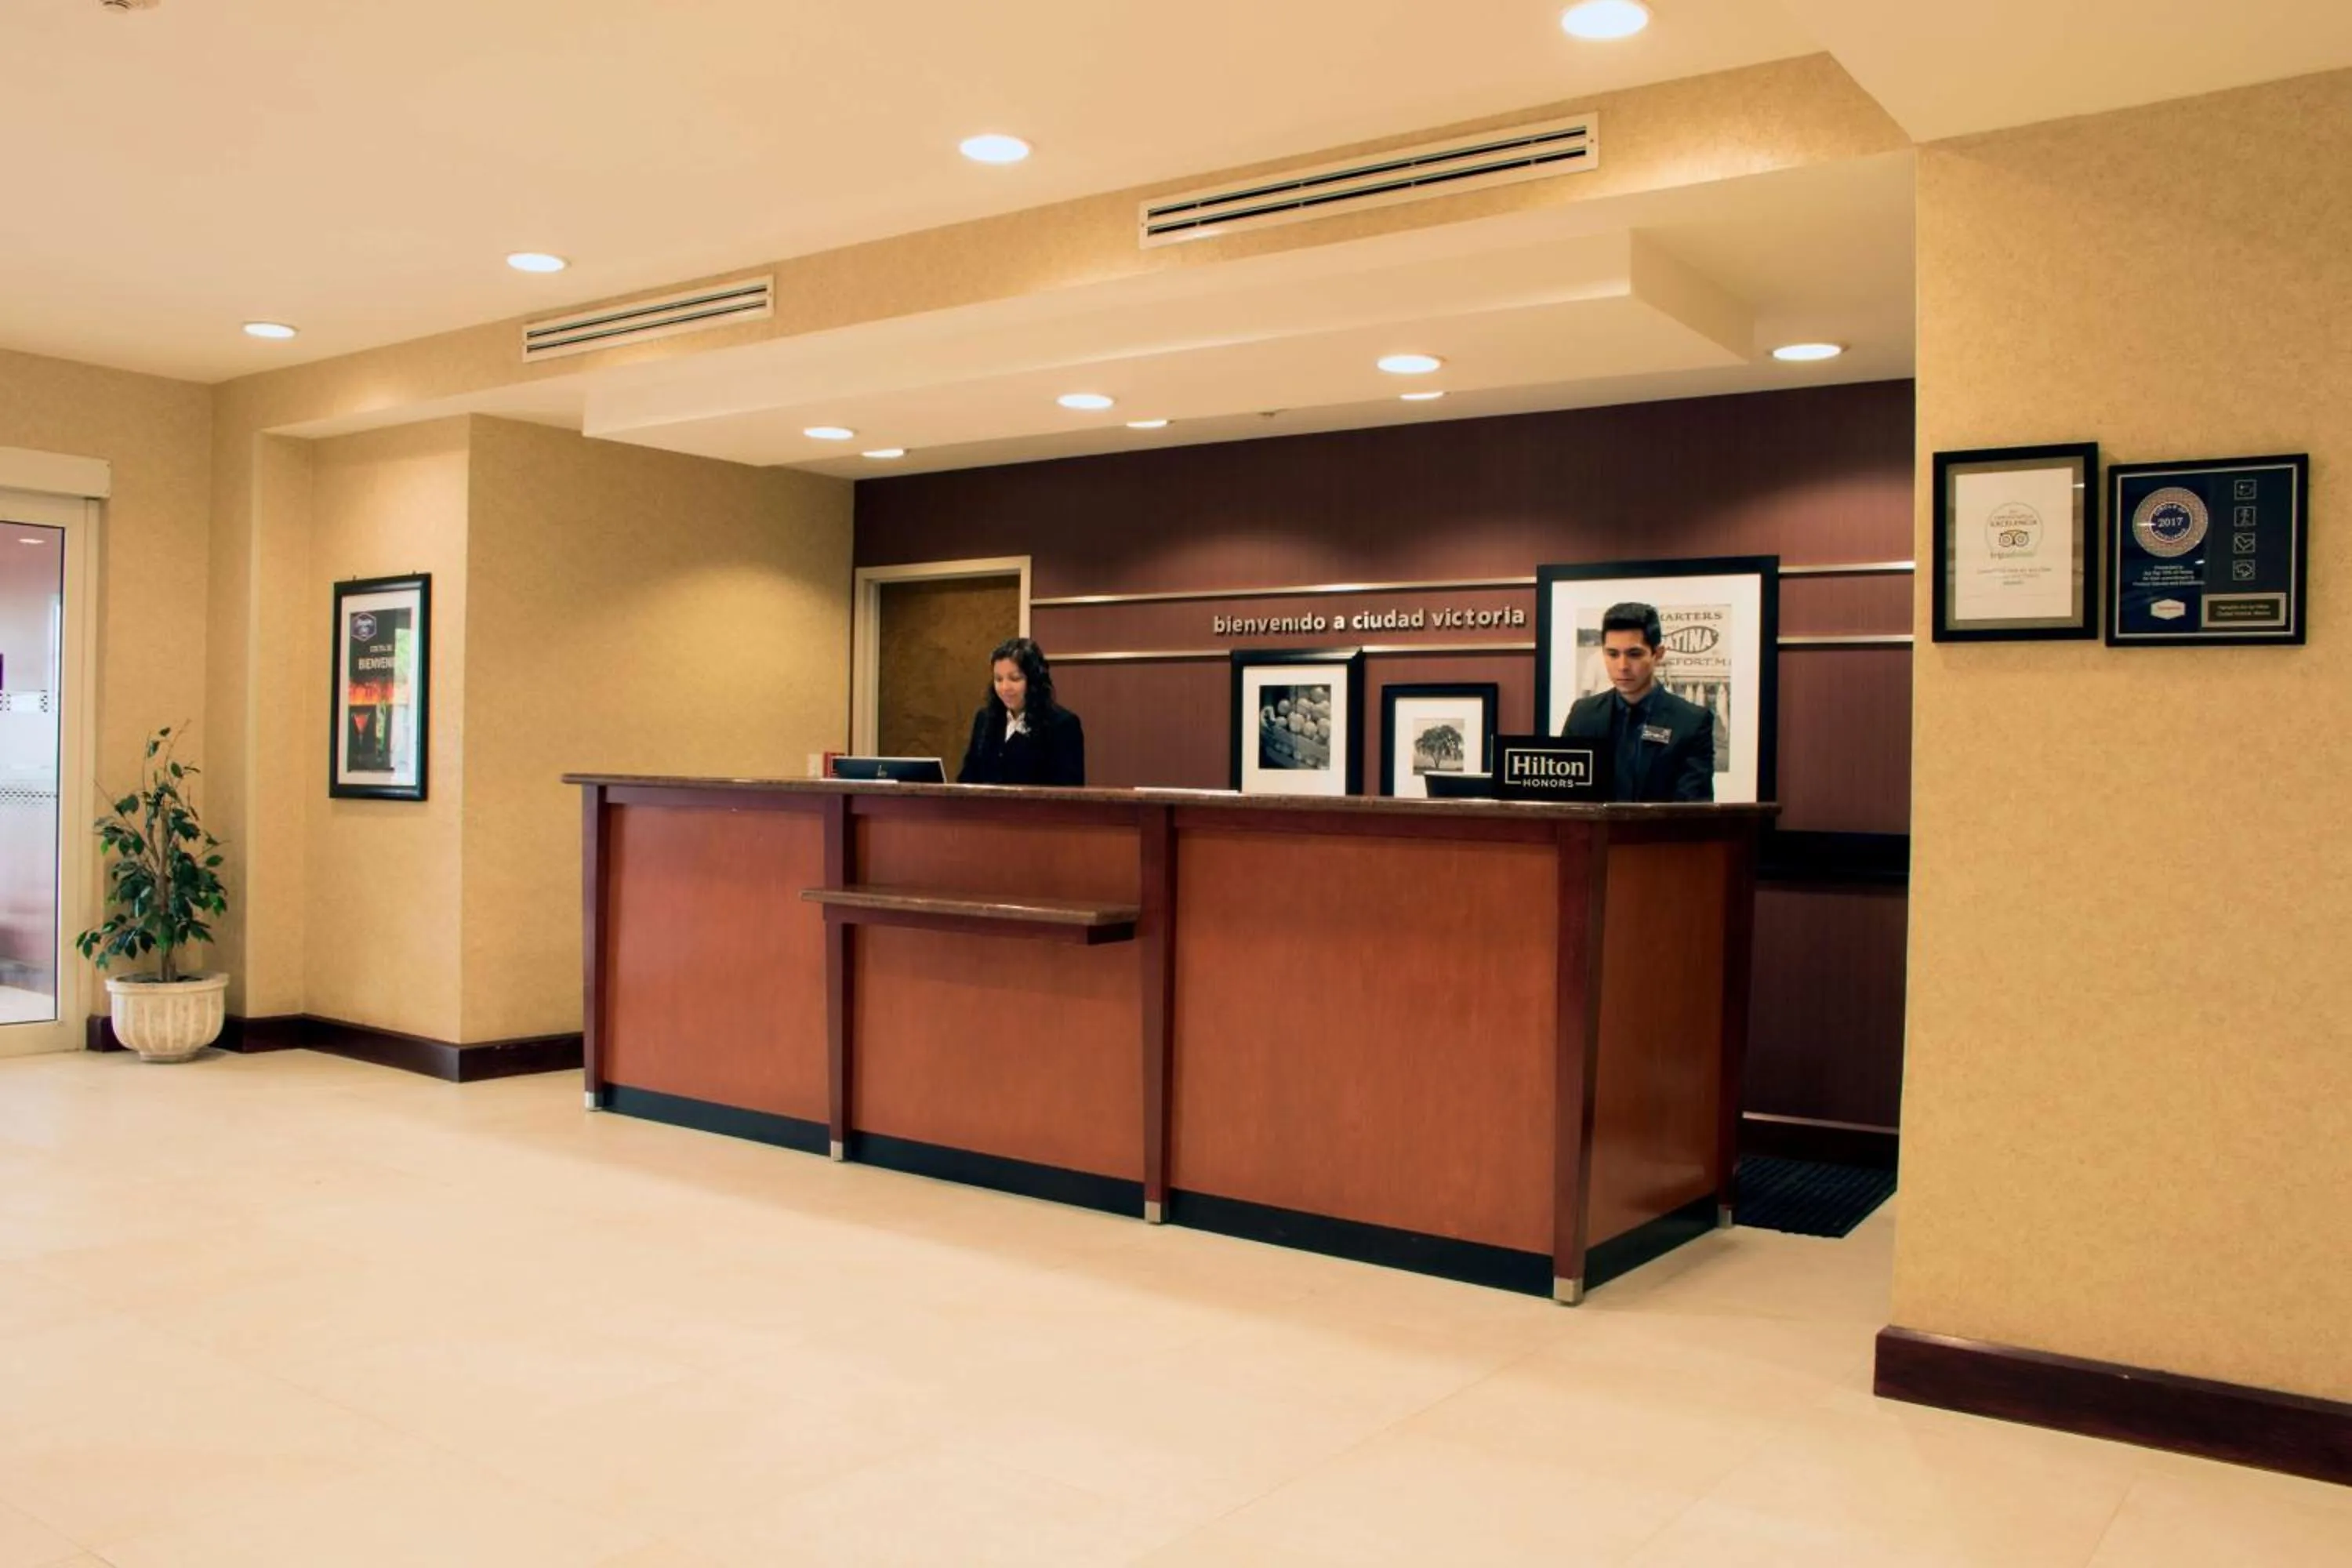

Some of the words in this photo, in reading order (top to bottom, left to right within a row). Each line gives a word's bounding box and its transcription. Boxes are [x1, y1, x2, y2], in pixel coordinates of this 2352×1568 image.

[2157, 517, 2183, 528] 2017
[1214, 613, 1326, 633] bienvenido
[1333, 615, 1346, 630] a
[1352, 609, 1425, 630] ciudad
[1432, 606, 1525, 626] victoria
[1512, 755, 1585, 776] Hilton
[1523, 779, 1574, 788] HONORS
